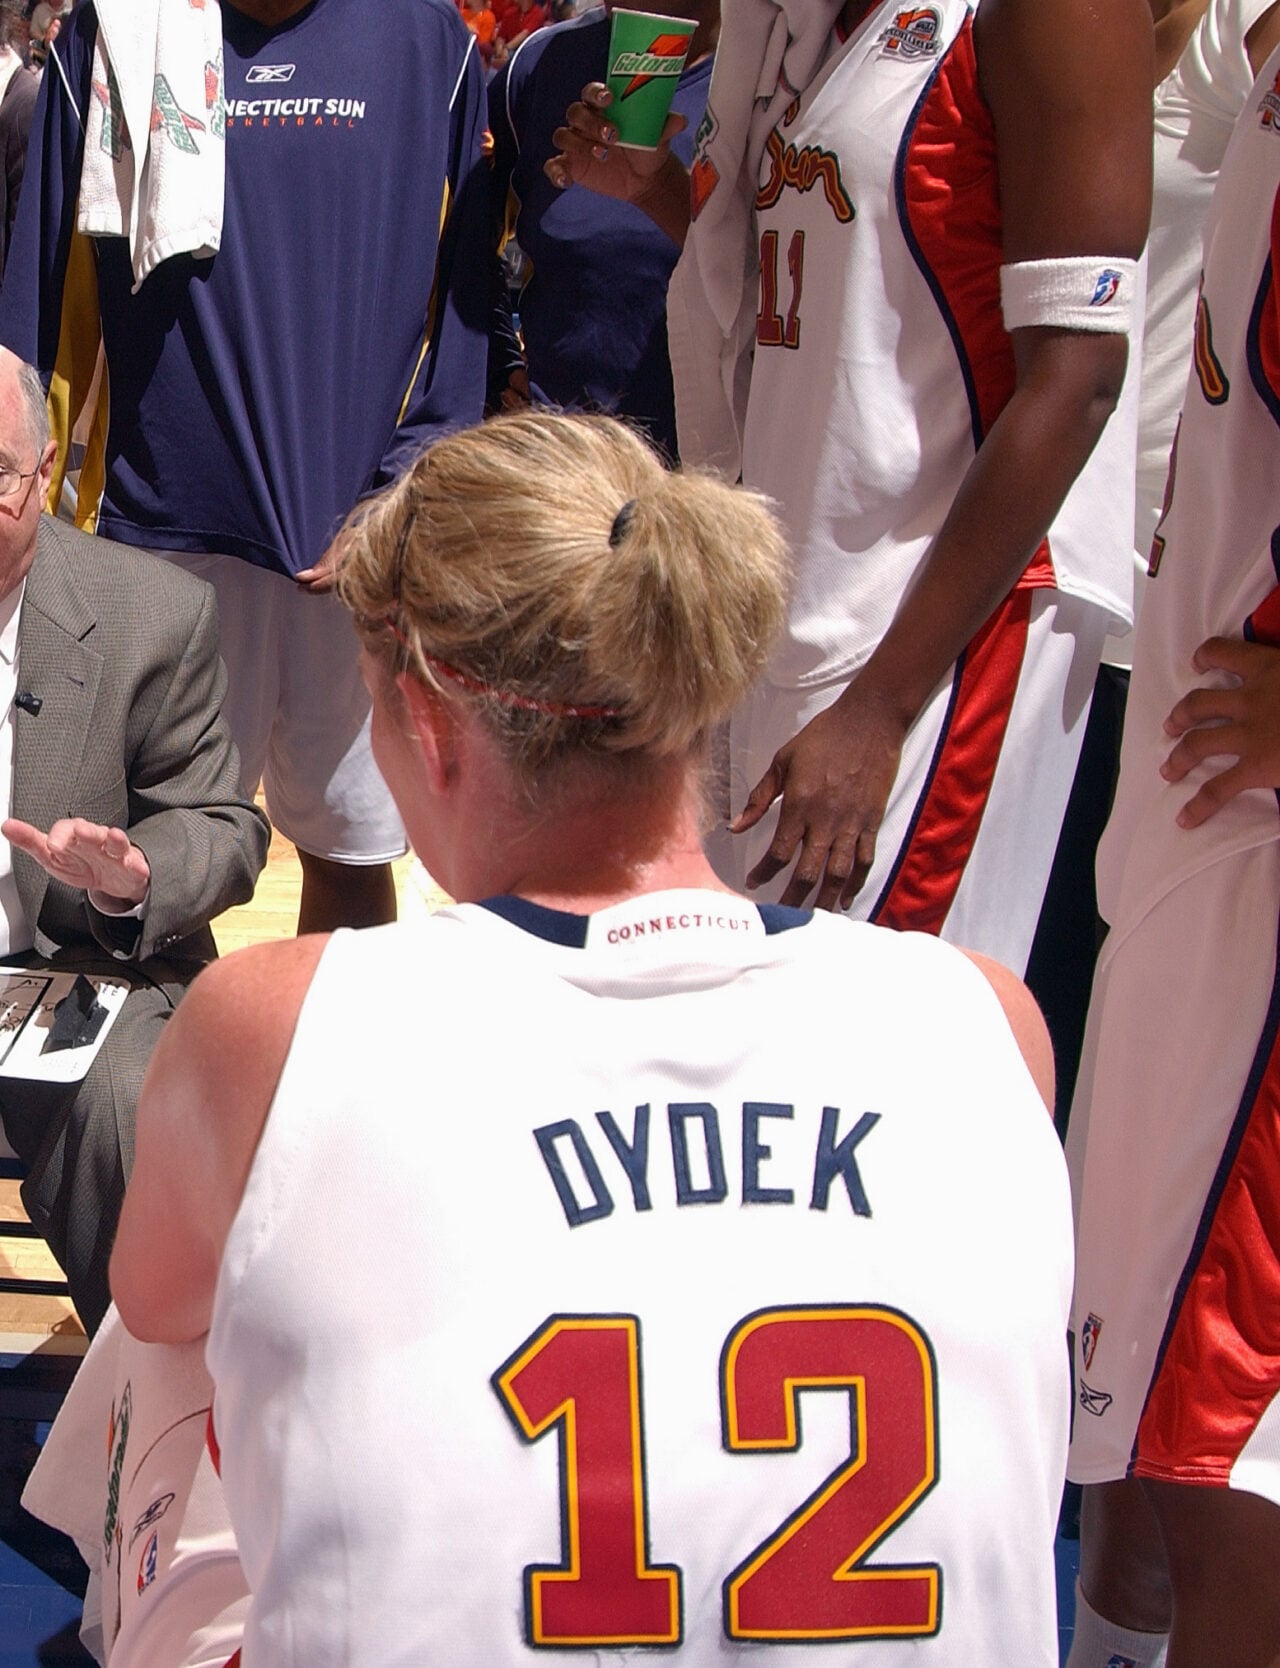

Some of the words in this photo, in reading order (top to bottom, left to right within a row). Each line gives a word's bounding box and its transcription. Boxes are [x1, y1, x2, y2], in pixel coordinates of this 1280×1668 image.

[324, 98, 366, 118] SUN
[756, 230, 805, 349] 11
[607, 914, 750, 944] CONNECTICUT
[532, 1101, 882, 1229] DYDEK
[490, 1302, 943, 1650] 12
